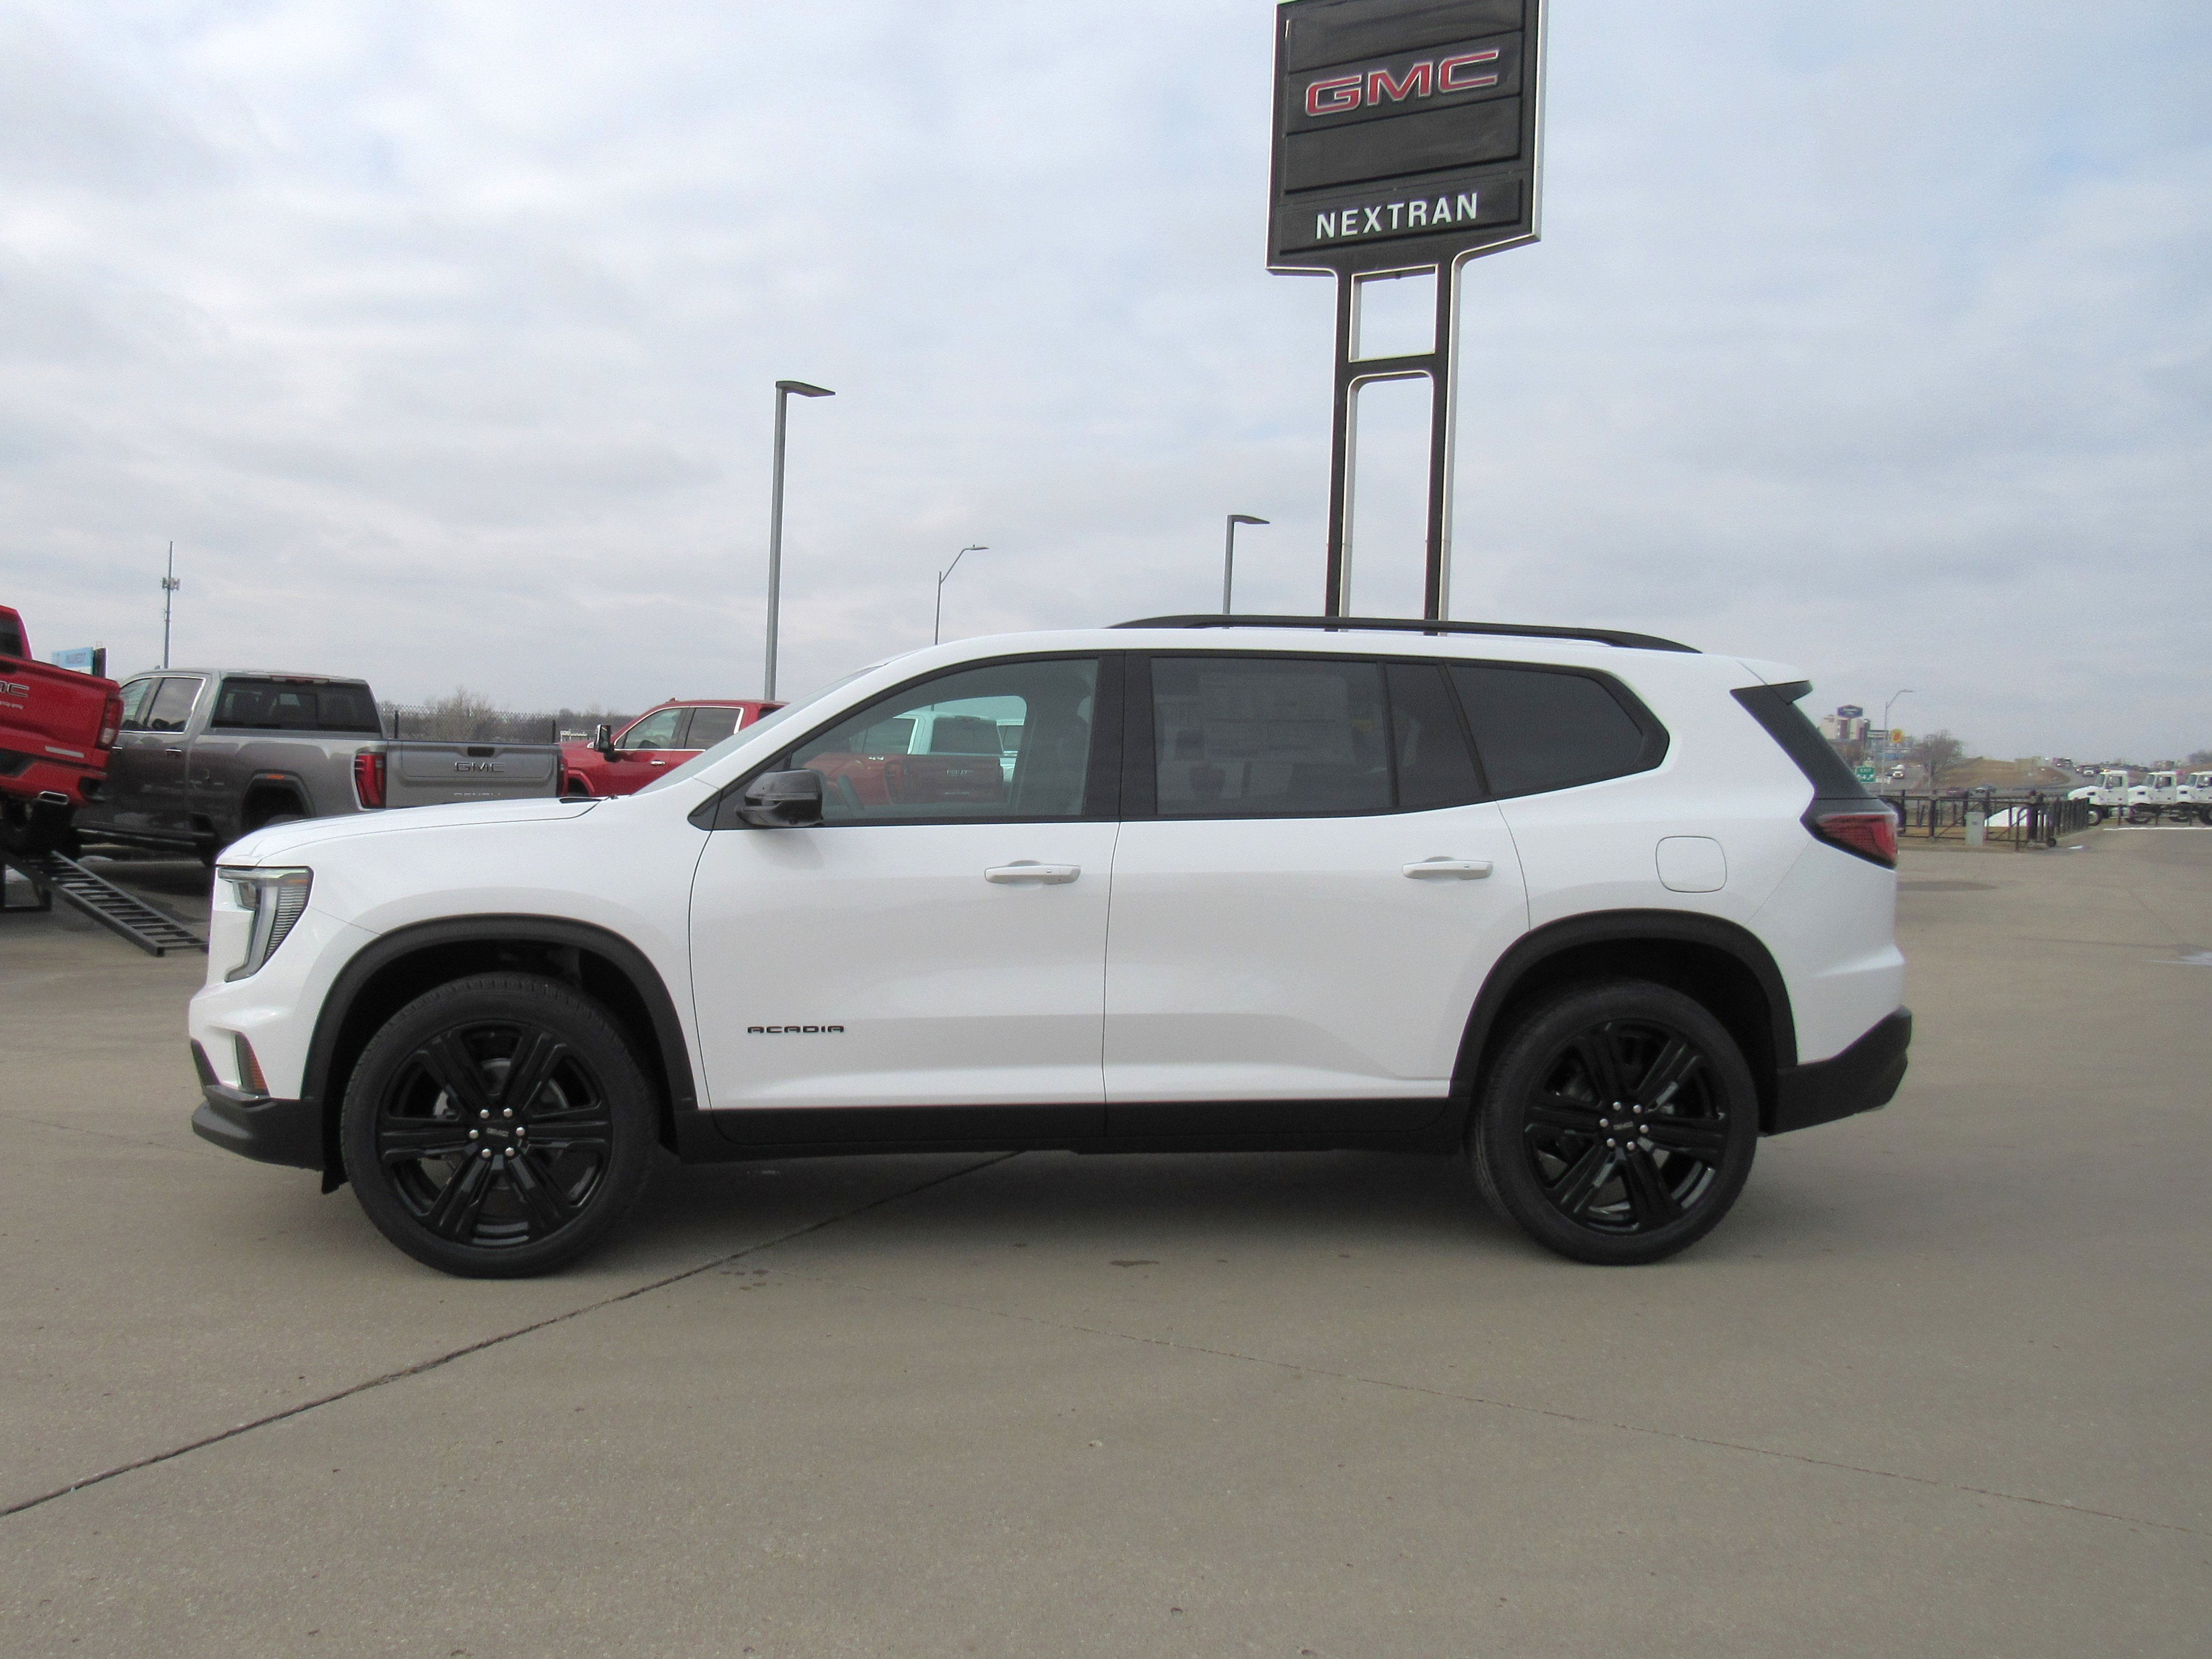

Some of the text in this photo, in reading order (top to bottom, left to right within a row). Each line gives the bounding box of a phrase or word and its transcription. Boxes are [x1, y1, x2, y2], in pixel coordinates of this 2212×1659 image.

[1305, 49, 1499, 116] GMC
[1315, 193, 1478, 240] NEXTRAN
[455, 762, 505, 772] GMC
[747, 1025, 844, 1033] ACADIA
